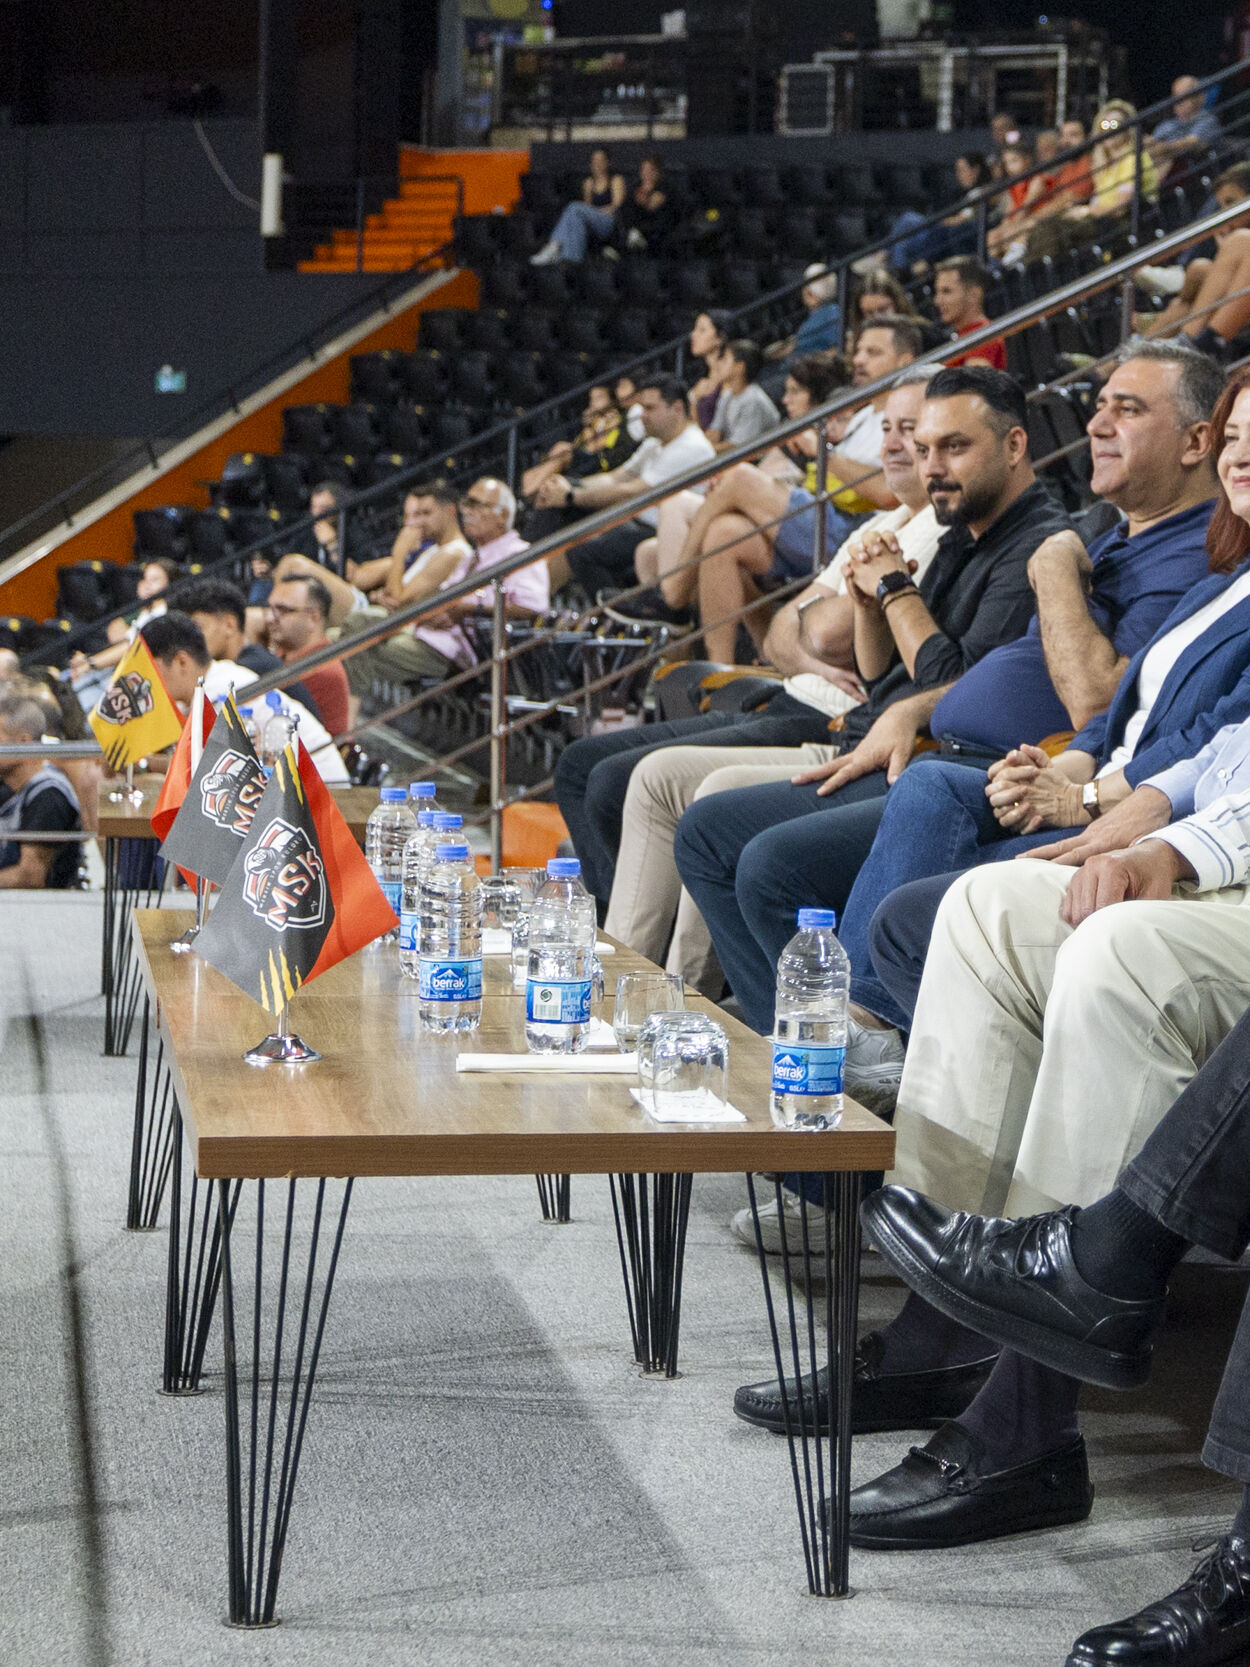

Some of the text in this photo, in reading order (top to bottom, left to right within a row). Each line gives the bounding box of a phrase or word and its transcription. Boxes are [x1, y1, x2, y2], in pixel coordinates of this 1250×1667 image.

[268, 851, 320, 925] MSK
[432, 977, 465, 988] berrak
[773, 1062, 805, 1079] berrak
